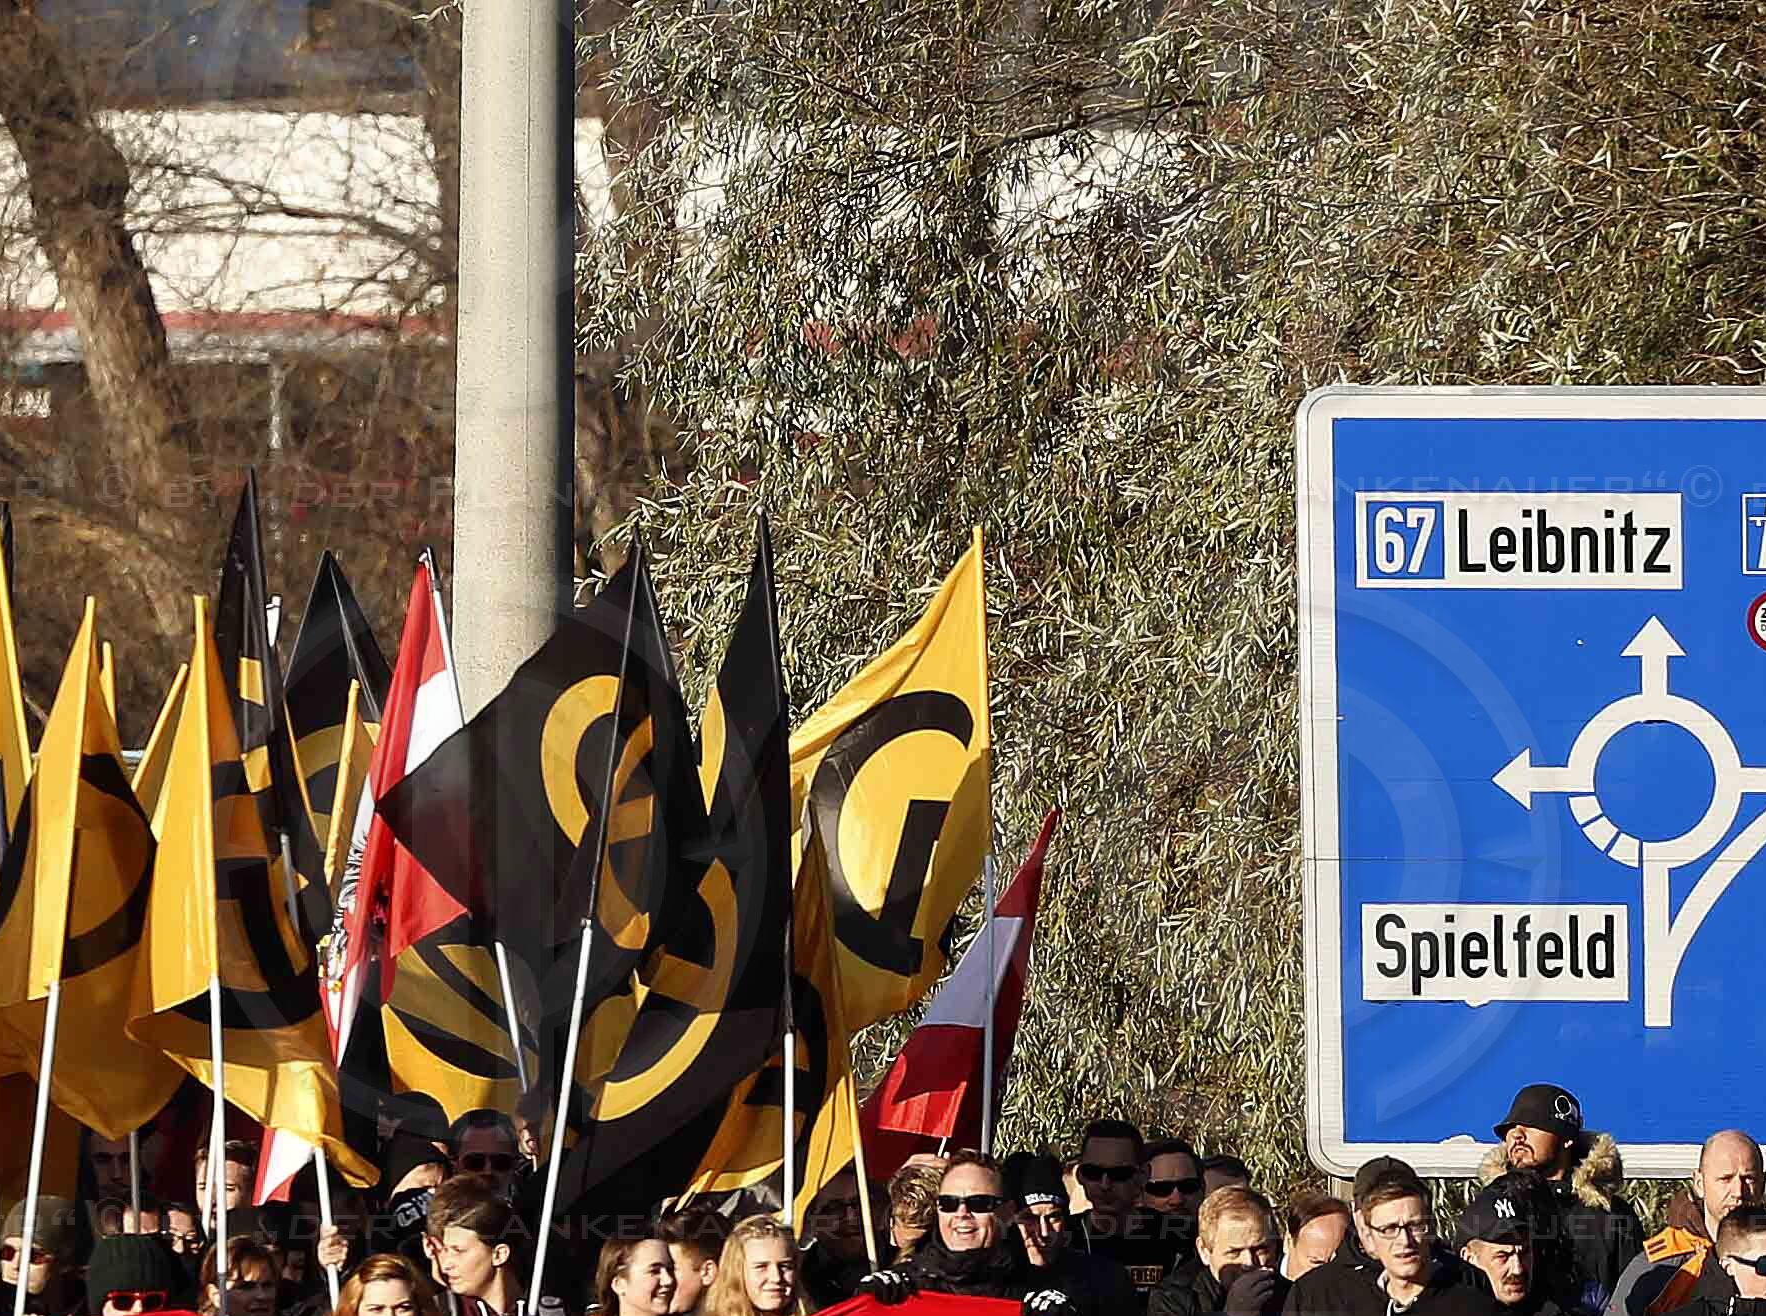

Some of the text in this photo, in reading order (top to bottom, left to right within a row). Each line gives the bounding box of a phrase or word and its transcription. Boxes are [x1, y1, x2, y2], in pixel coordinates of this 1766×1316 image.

[1374, 506, 1672, 574] 67 Leibnitz
[1375, 913, 1615, 996] Spielfeld
